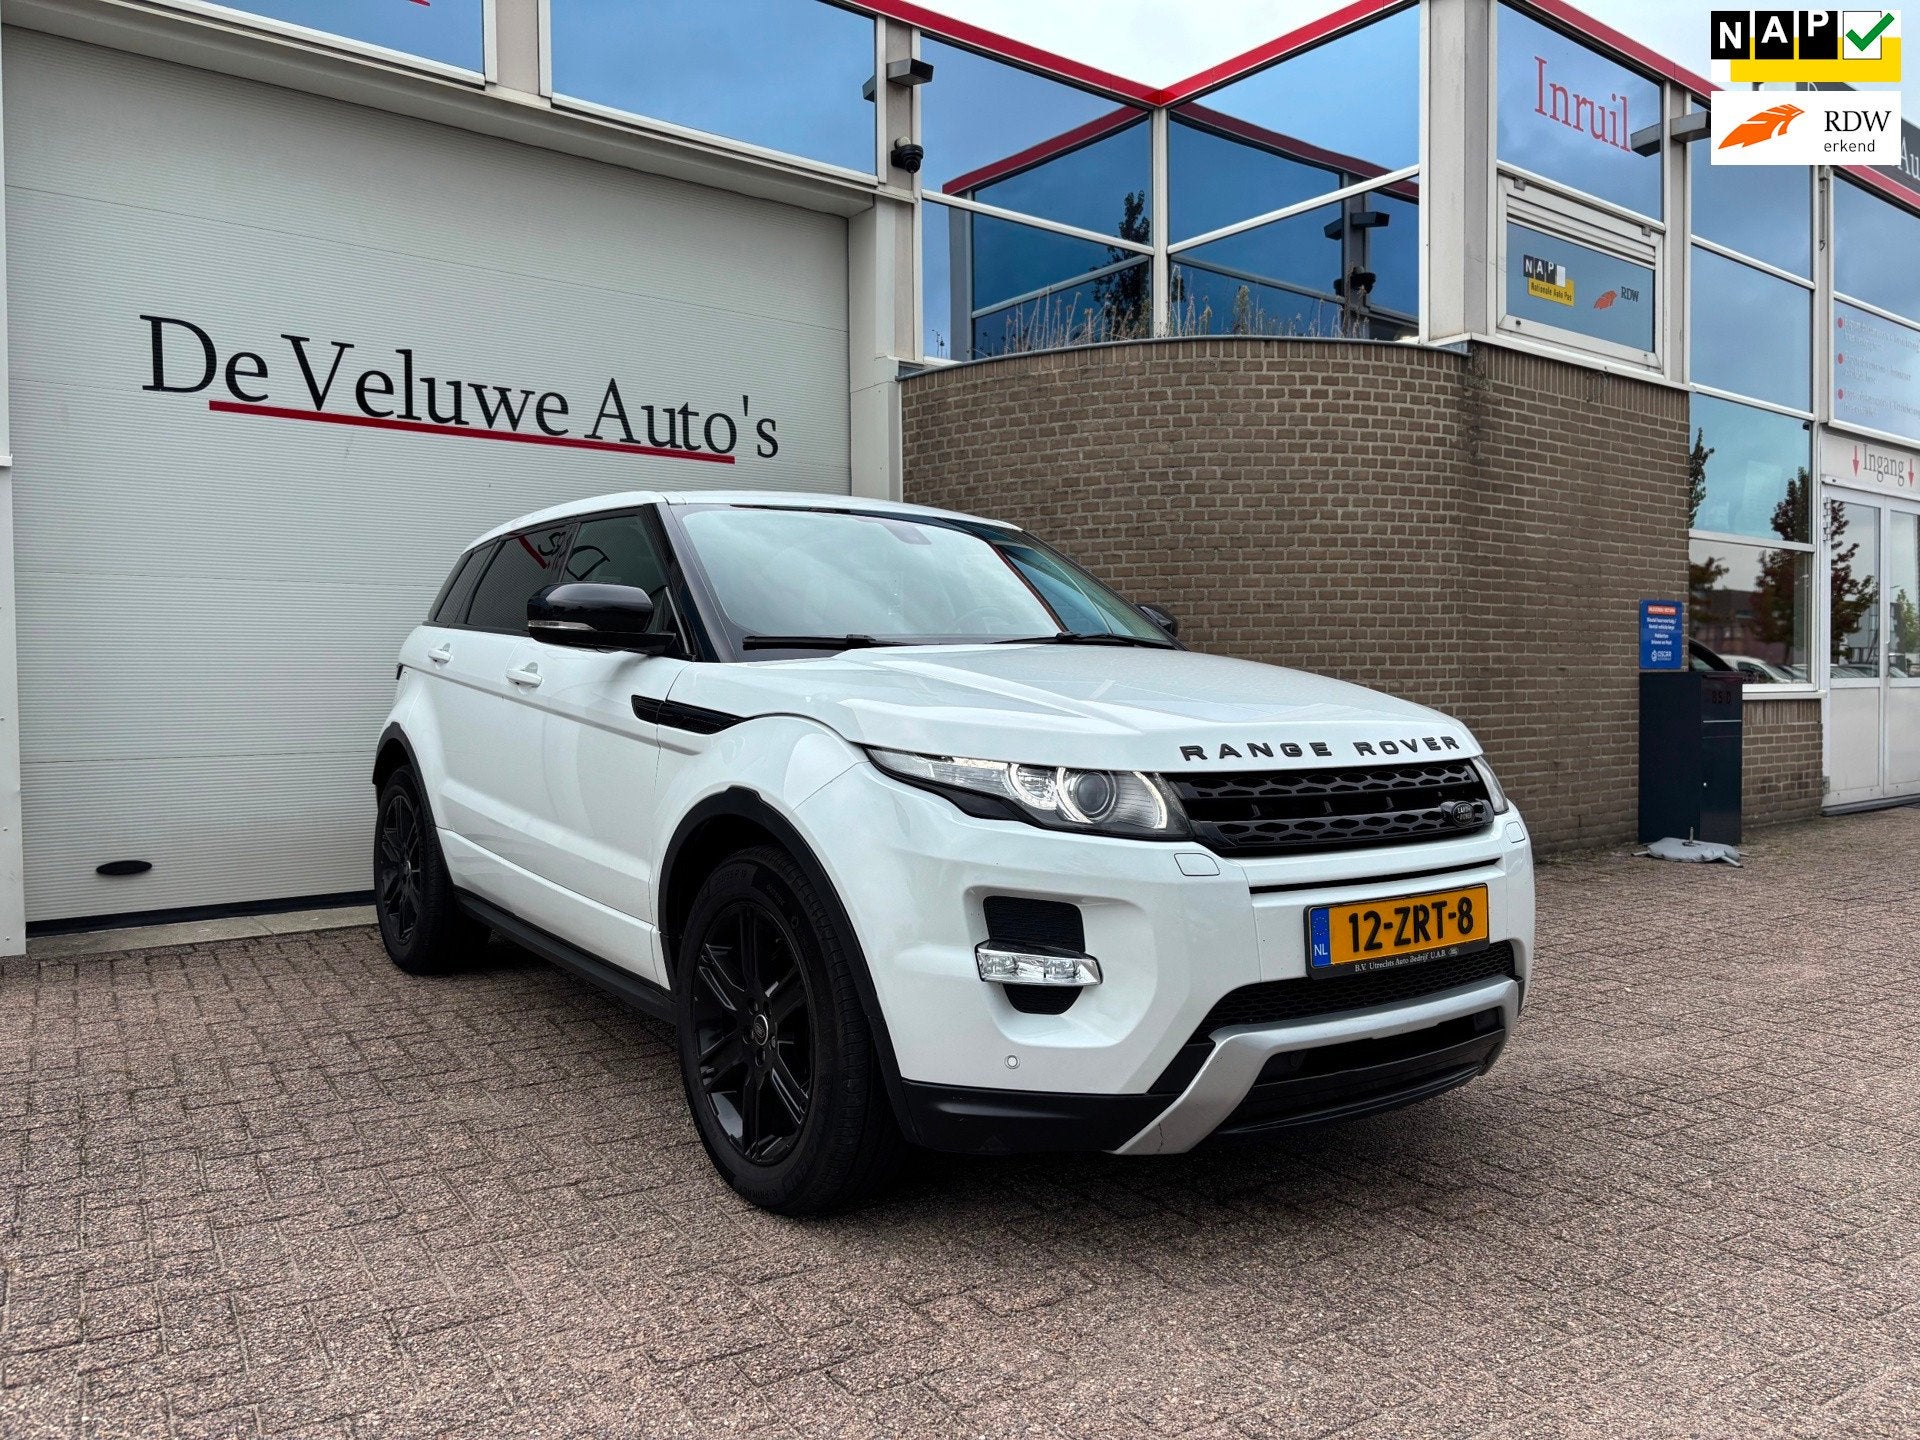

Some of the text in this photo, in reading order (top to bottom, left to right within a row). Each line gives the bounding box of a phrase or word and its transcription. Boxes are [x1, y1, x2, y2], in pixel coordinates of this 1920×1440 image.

[1535, 56, 1631, 152] Inruil
[1525, 259, 1555, 274] NAP
[1621, 286, 1639, 302] RDW
[139, 314, 779, 459] De Veluwe Auto's
[1863, 443, 1905, 487] Ingang
[1179, 735, 1460, 762] RANGE ROVER
[1348, 896, 1474, 953] 12-ZRT-8
[1314, 943, 1328, 957] NL
[1369, 960, 1394, 970] Utrechts
[1395, 957, 1409, 966] Auto
[1410, 952, 1429, 963] Bedrijf
